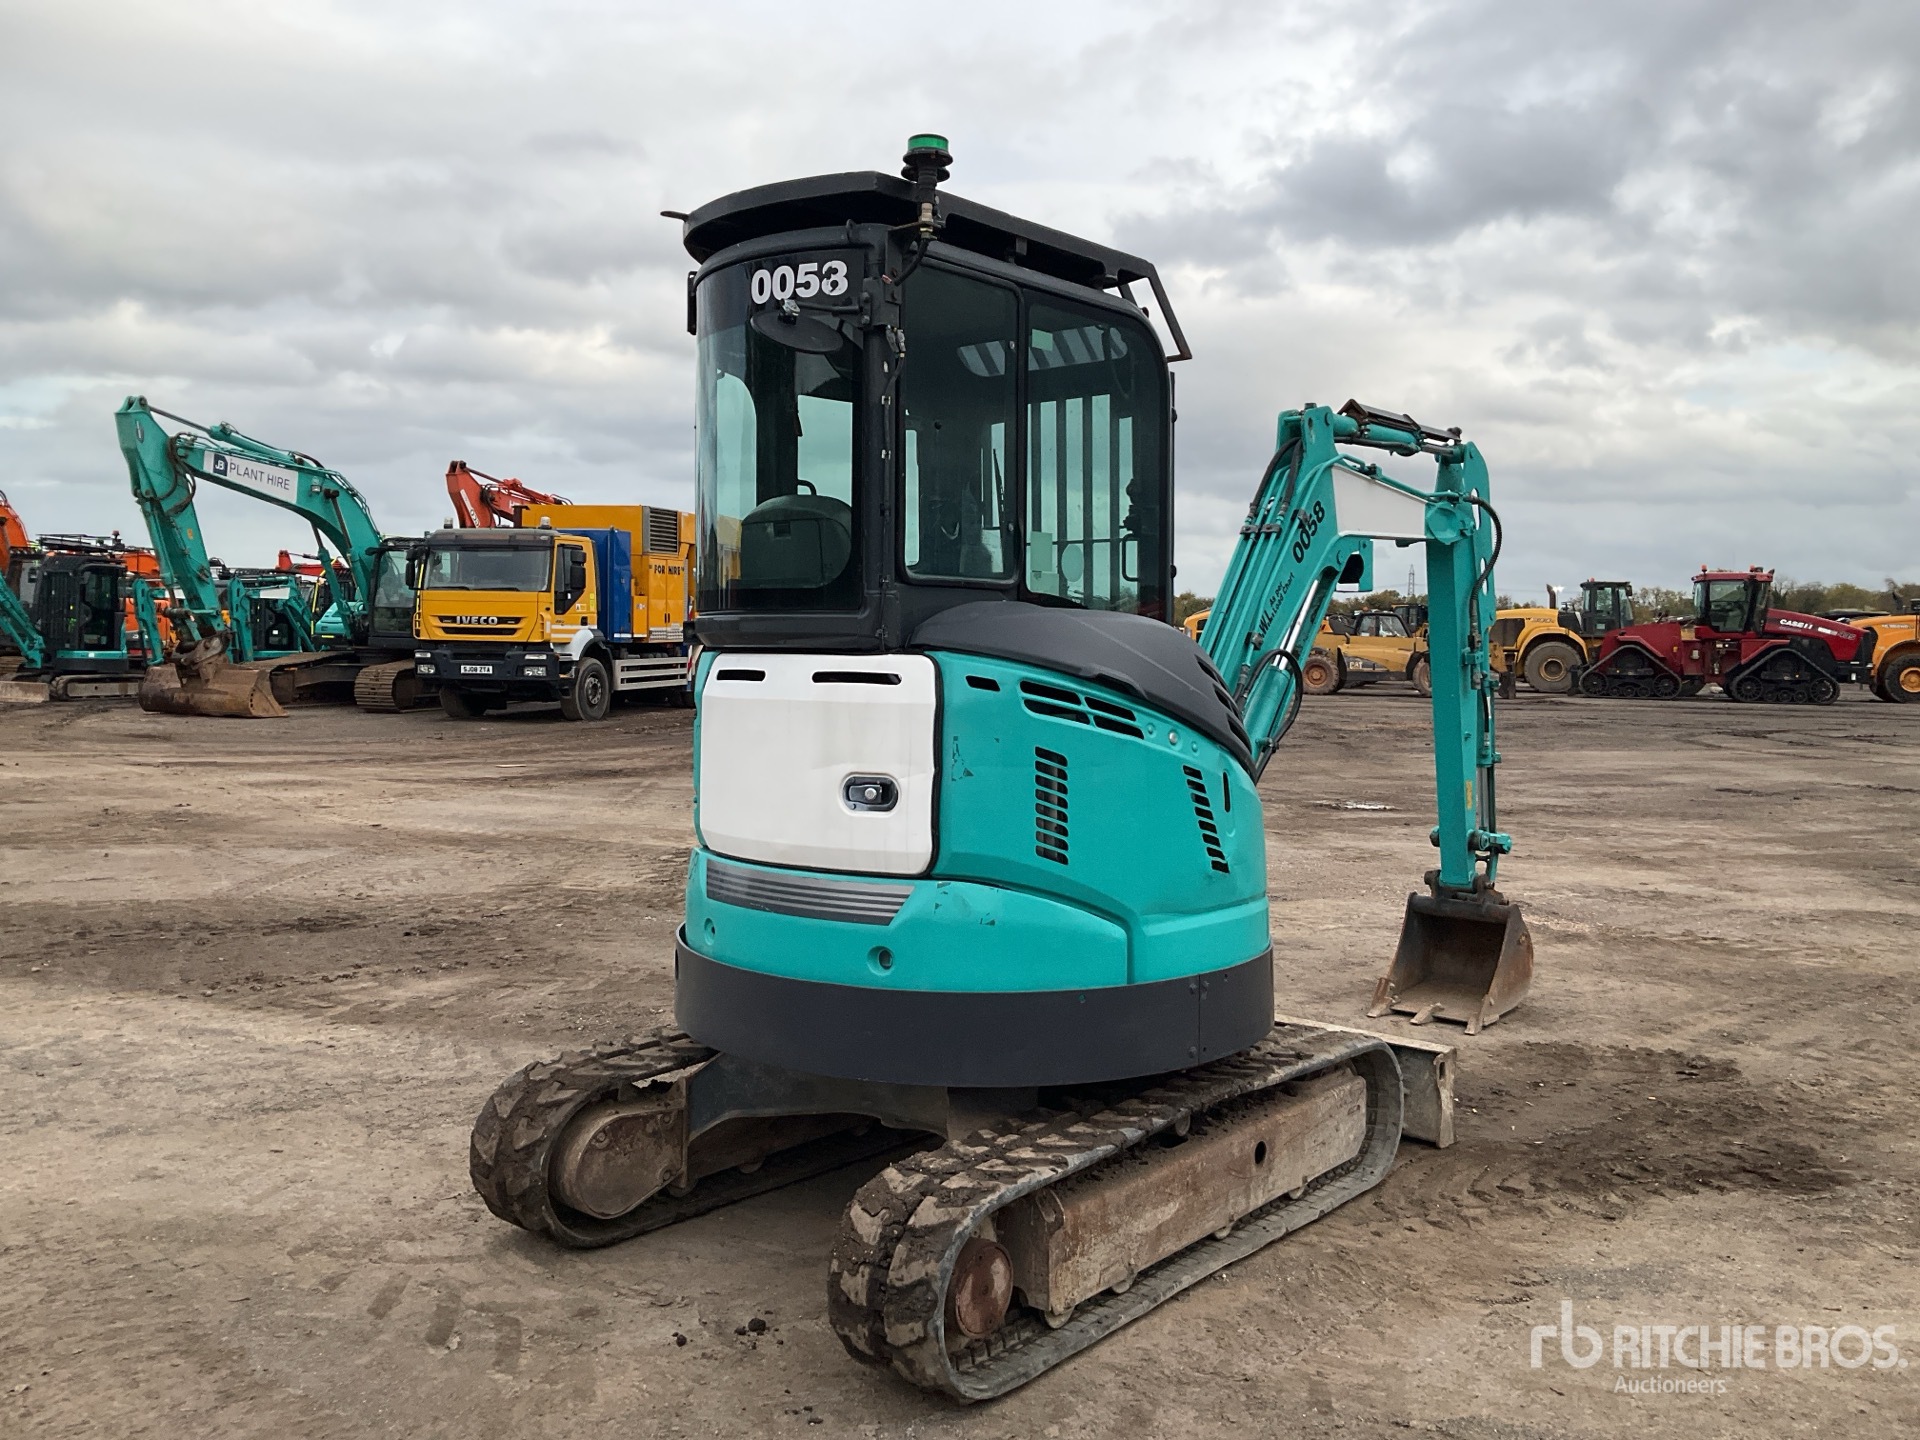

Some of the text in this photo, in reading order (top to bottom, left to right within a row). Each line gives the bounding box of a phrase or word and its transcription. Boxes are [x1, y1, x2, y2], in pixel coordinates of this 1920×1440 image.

[229, 460, 290, 491] PLANT HIRE
[1292, 500, 1325, 563] 0058
[1273, 571, 1295, 612] Load Chart
[456, 615, 498, 625] IVECO
[1780, 619, 1804, 628] CASE
[1350, 661, 1363, 669] CAT
